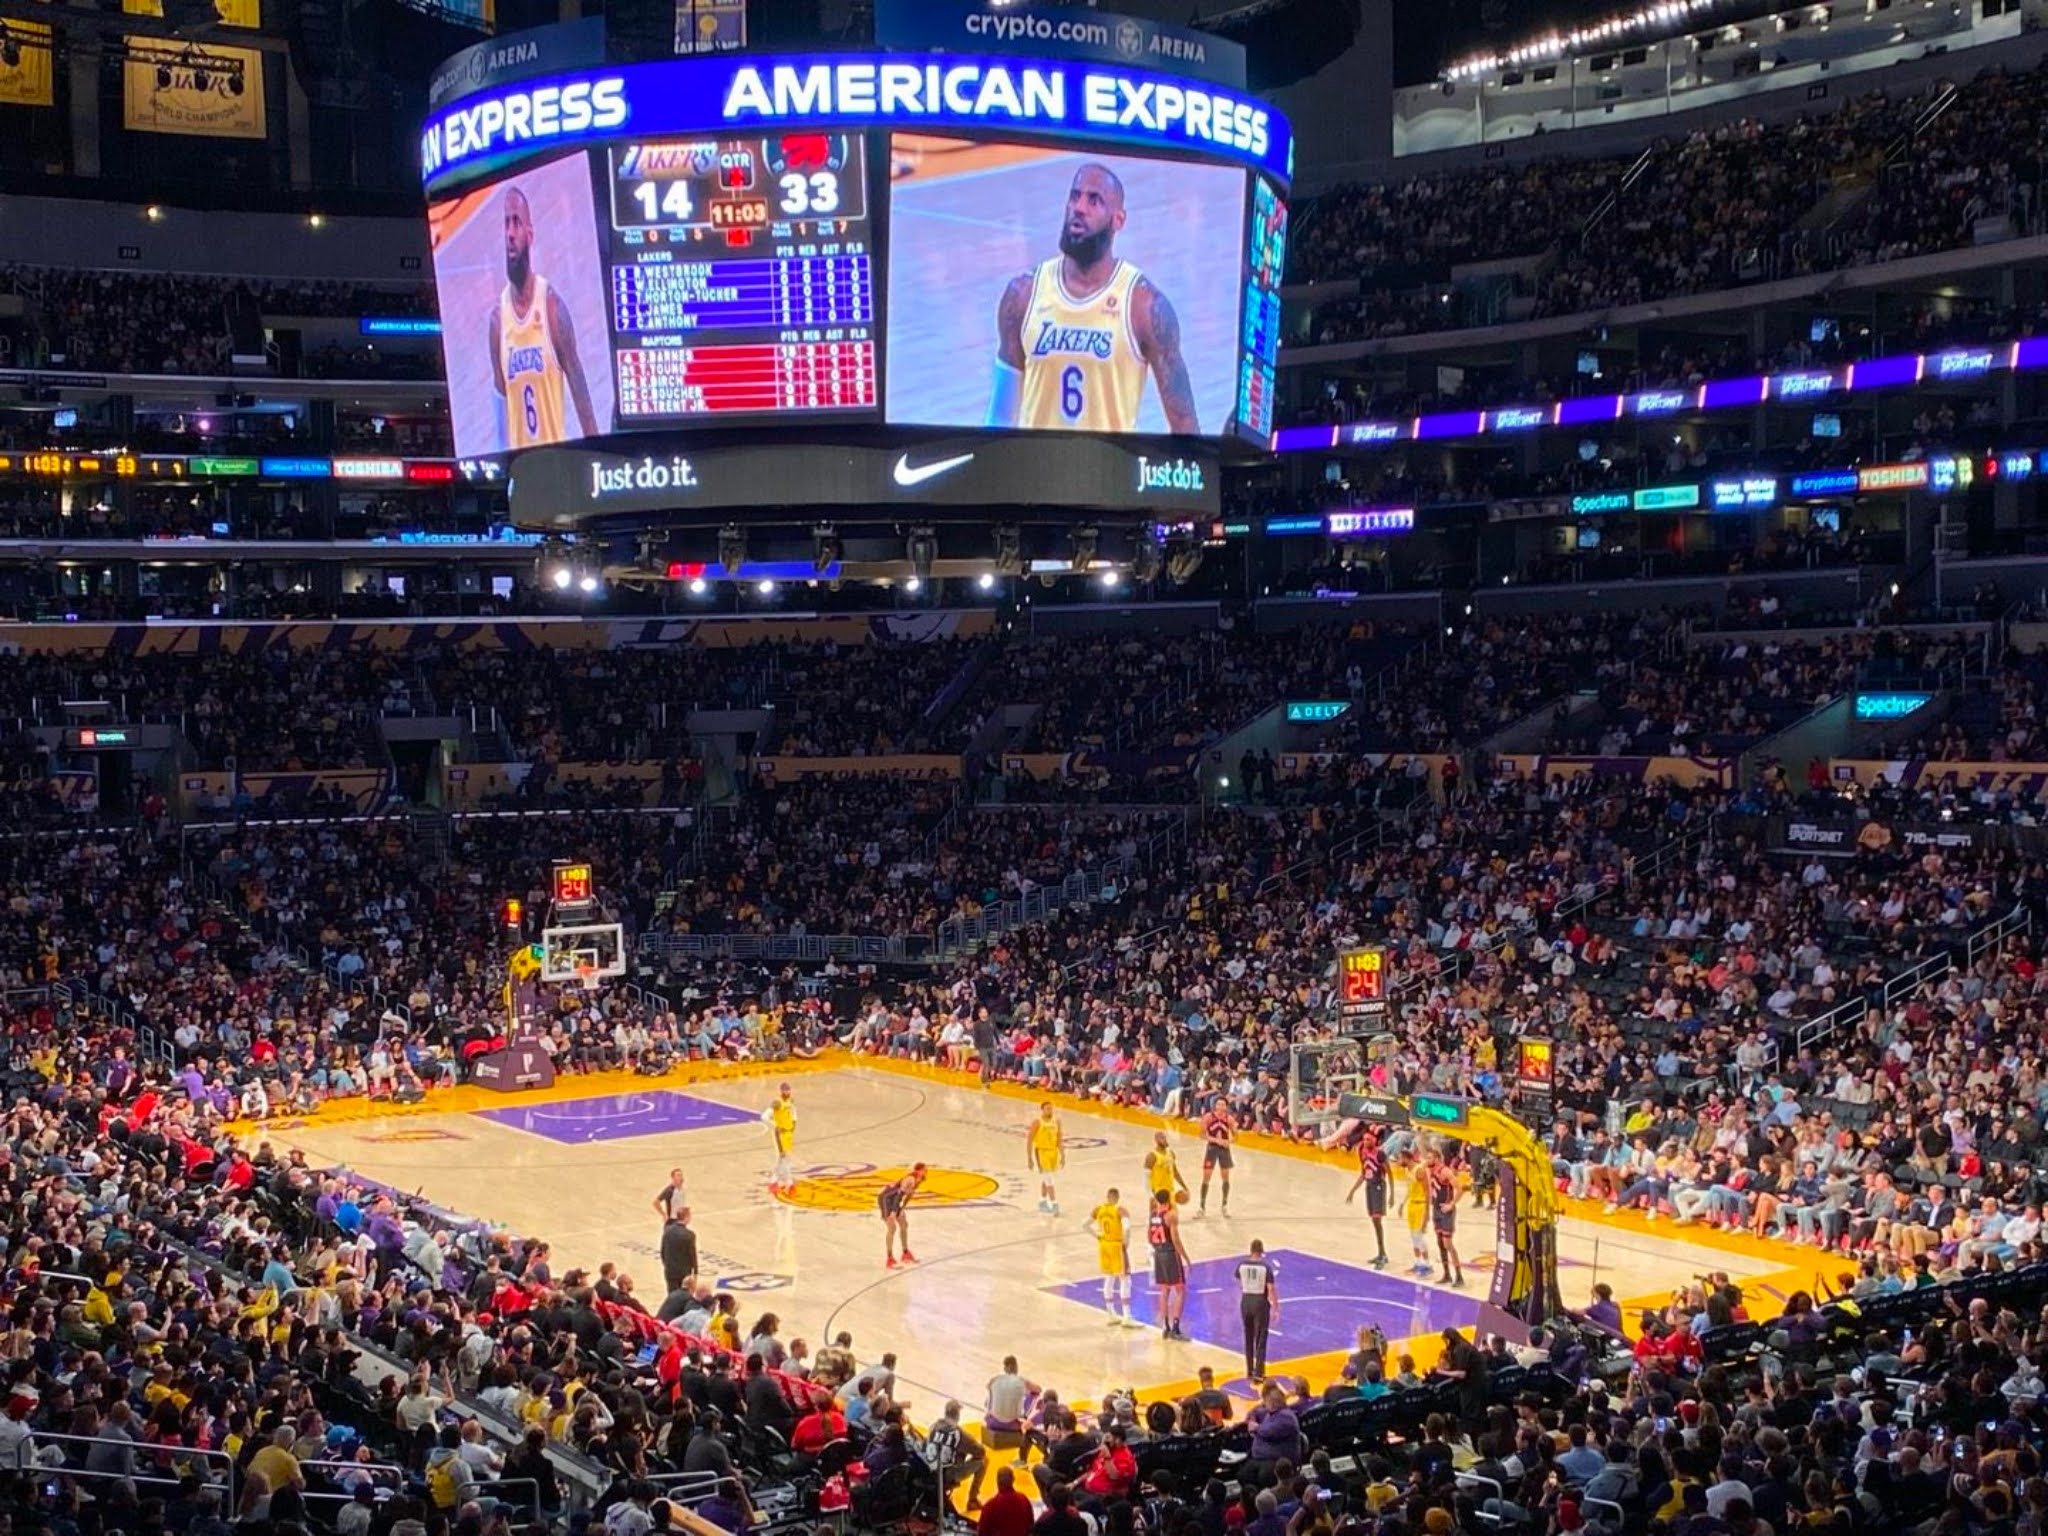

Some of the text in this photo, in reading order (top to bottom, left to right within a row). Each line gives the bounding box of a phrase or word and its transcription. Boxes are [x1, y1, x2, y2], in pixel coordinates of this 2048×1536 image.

[965, 11, 1206, 63] crypto.com ARENA
[489, 41, 539, 72] ARENA
[446, 78, 628, 160] EXPRESS
[723, 64, 1269, 157] AMERICAN EXPRESS
[720, 153, 749, 168] QTR
[634, 180, 693, 220] 14
[779, 172, 839, 213] 33
[712, 204, 766, 223] 11:03
[826, 258, 834, 271] 0
[780, 272, 789, 286] 0
[803, 272, 811, 284] 0
[826, 271, 835, 284] 0
[851, 269, 859, 282] 0
[803, 284, 812, 297] 0
[827, 283, 835, 296] 0
[851, 282, 860, 295] 0
[852, 295, 860, 308] 0
[636, 314, 698, 330] C.ANTHONY
[828, 309, 836, 322] 0
[852, 308, 861, 321] 0
[1031, 320, 1114, 359] LAKERS
[507, 346, 545, 380] LAKERS
[1062, 365, 1084, 419] 6
[523, 384, 538, 436] 6
[117, 457, 136, 475] 33
[300, 464, 329, 473] ULTRA
[336, 463, 400, 476] TOSHIBA
[1137, 456, 1204, 492] Just do it.
[592, 456, 697, 498] Just do it.
[1803, 475, 1858, 491] crypto.com
[1860, 467, 1928, 488] TOSHIBA
[1573, 494, 1628, 514] Spectrum
[1788, 830, 1844, 843] SPORTSNET
[1904, 832, 1926, 845] 710
[561, 881, 586, 899] 24
[1347, 953, 1381, 971] 11:03
[1350, 972, 1378, 1000] 24
